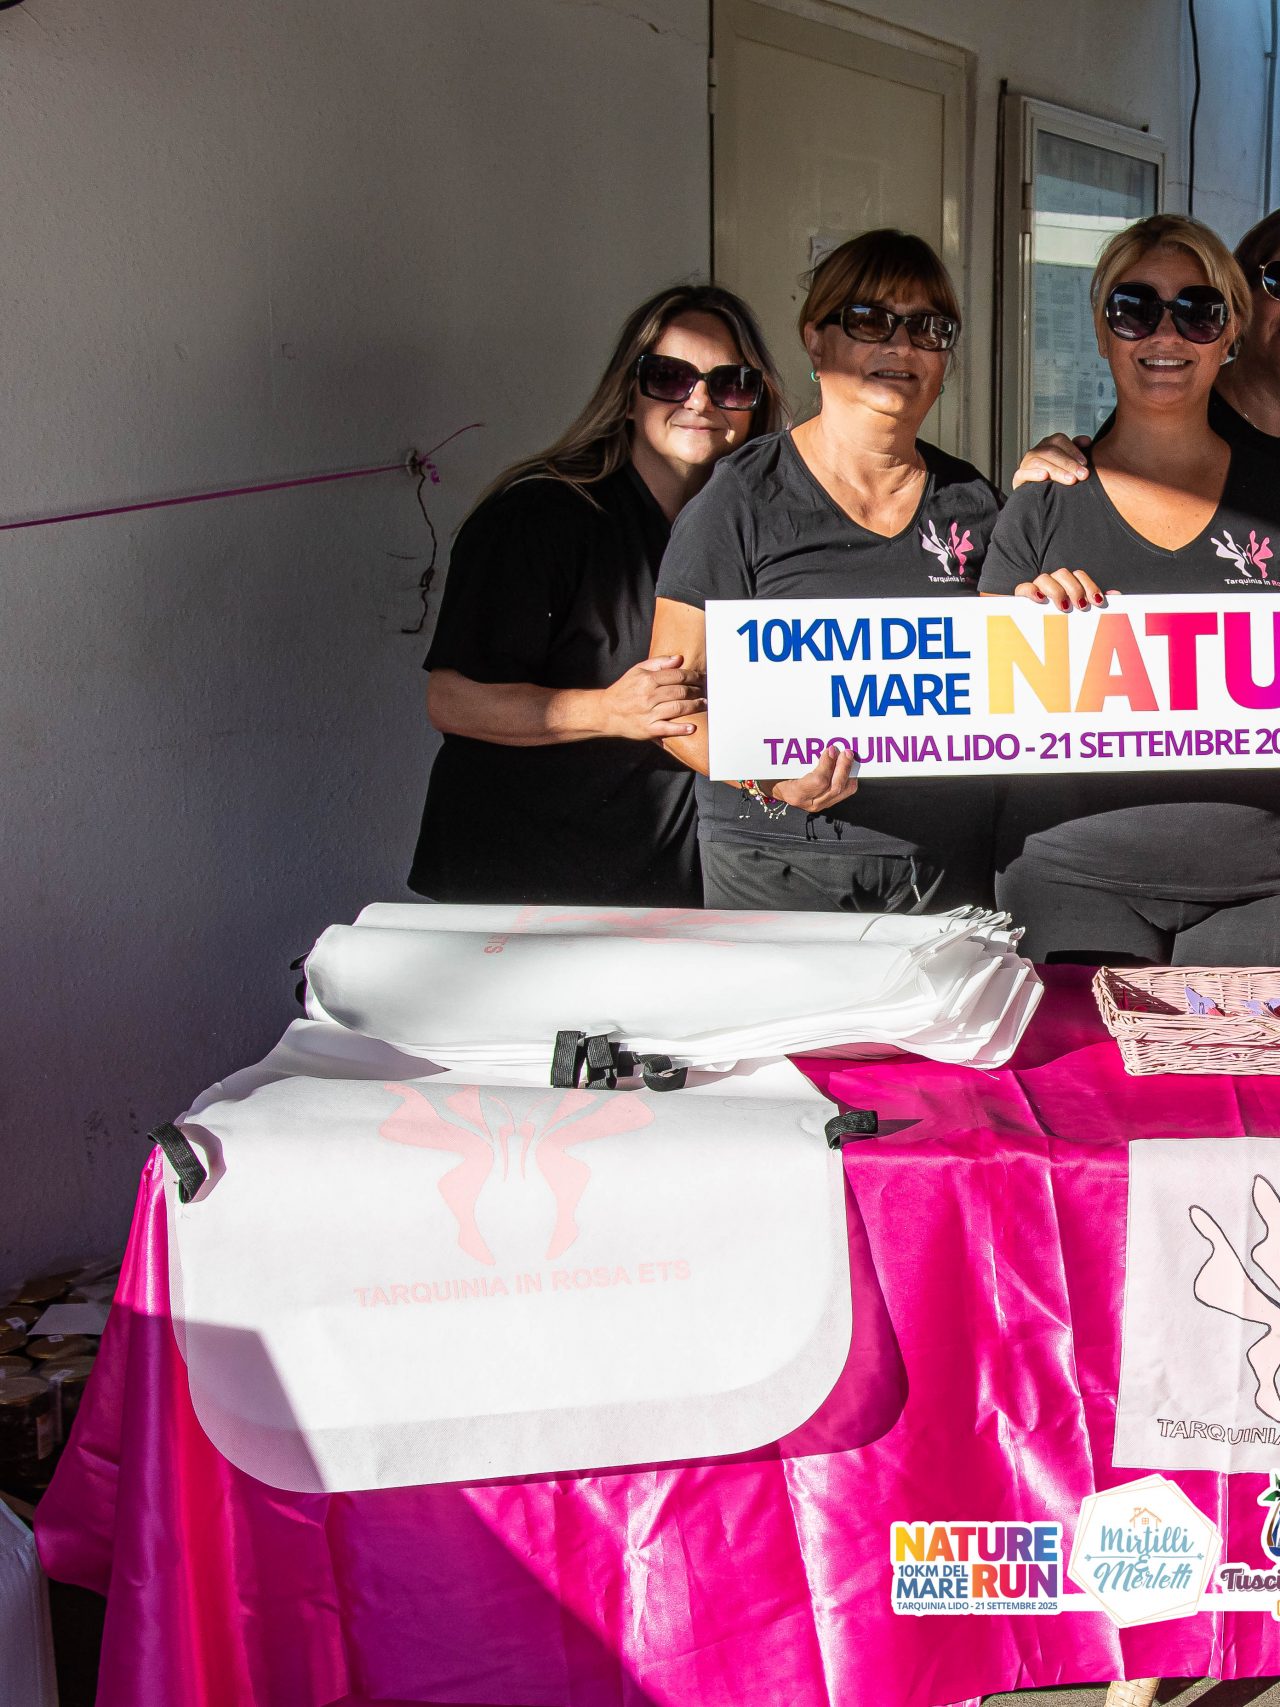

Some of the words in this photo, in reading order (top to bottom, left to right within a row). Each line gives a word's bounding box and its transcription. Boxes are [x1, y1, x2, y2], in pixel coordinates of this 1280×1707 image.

[1224, 578, 1262, 586] Tarquinia
[737, 617, 871, 662] 10KM
[881, 616, 971, 660] DEL
[830, 673, 971, 718] MARE
[947, 733, 1021, 762] LIDO
[1040, 732, 1072, 760] 21
[1080, 728, 1250, 759] SETTEMBRE
[353, 1275, 509, 1308] TARQUINIA
[515, 1273, 543, 1294] IN
[550, 1265, 632, 1291] ROSA
[637, 1259, 692, 1284] ETS
